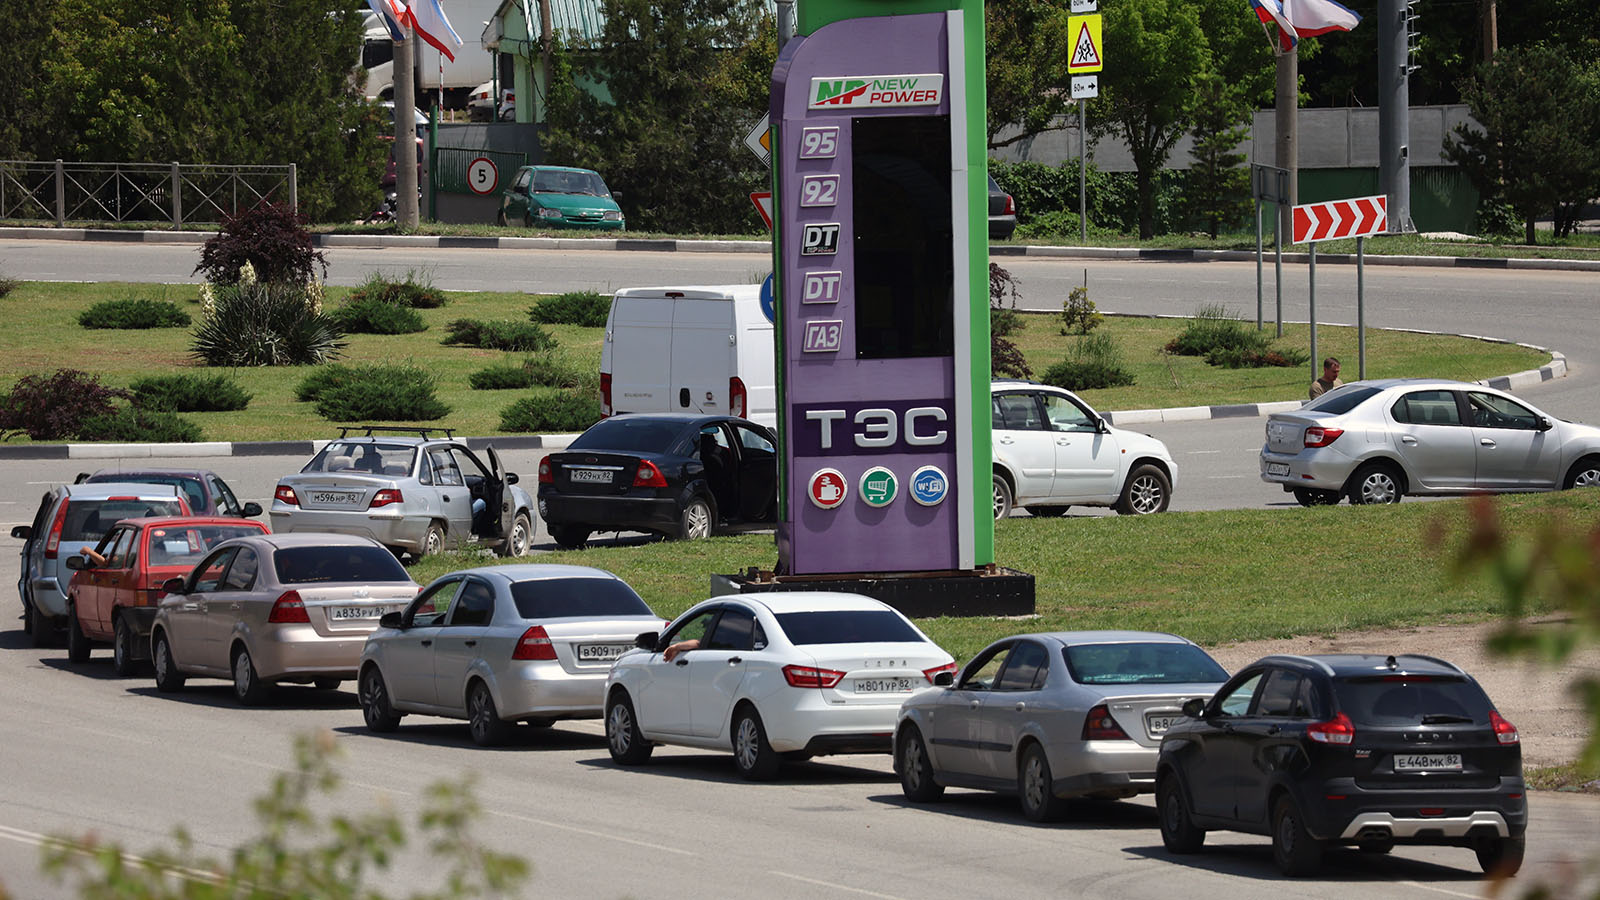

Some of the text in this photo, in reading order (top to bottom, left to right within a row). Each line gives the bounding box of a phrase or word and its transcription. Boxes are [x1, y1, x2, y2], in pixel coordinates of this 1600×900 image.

[812, 79, 918, 105] NP NEW
[870, 90, 937, 103] POWER
[805, 132, 836, 155] 95
[478, 169, 486, 183] 5
[805, 180, 836, 203] 92
[805, 226, 838, 247] DT
[805, 276, 839, 300] DT
[806, 325, 839, 348] ГАЗ
[805, 406, 948, 449] ТЭС
